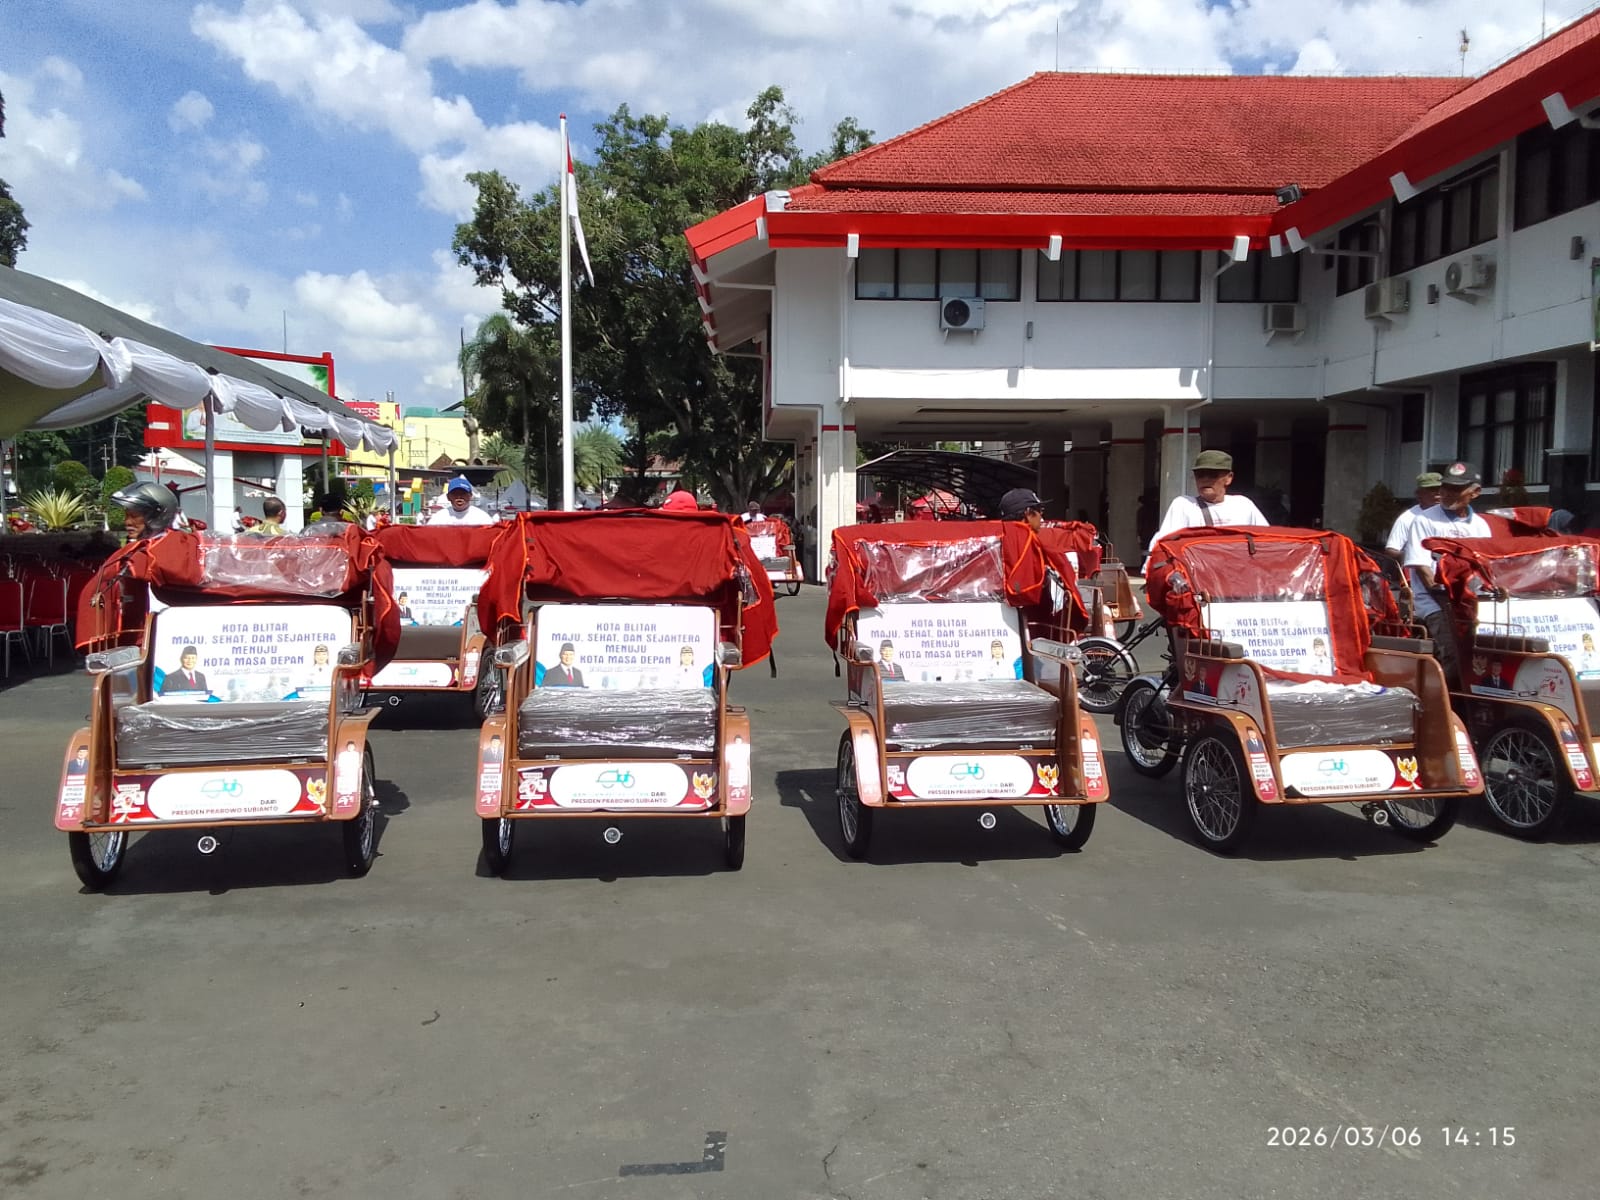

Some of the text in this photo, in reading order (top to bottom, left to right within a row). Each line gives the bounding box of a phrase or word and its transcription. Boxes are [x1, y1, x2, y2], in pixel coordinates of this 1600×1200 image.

[911, 619, 967, 627] KOTA BLITAR
[1236, 618, 1258, 626] KOTA
[1512, 614, 1559, 624] KOTA BLITAR
[222, 622, 289, 633] KOTA BLITAR
[596, 623, 657, 632] KOTA BLITAR
[1263, 628, 1278, 636] DAN
[1282, 627, 1329, 636] SEJAHTERA
[1536, 625, 1551, 633] DAN
[1554, 623, 1595, 633] SEJAHTERA
[252, 634, 273, 644] DAN
[277, 632, 336, 643] SEJAHTERA
[937, 629, 955, 638] DAN
[958, 629, 1009, 637] SEJAHTERA
[623, 634, 643, 642] DAN
[646, 634, 700, 643] SEJAHTERA
[1248, 638, 1284, 647] MENUJU
[605, 644, 647, 653] MENUJU
[921, 640, 960, 648] MENUJU
[1553, 644, 1577, 652] DEPAN
[232, 646, 278, 655] MENUJU
[899, 650, 983, 659] KOTA MASA DEPAN
[1252, 649, 1277, 657] MASA
[1280, 648, 1307, 657] DEPAN
[203, 656, 304, 667] KOTA MASA DEPAN
[579, 655, 671, 664] KOTA MASA DEPAN
